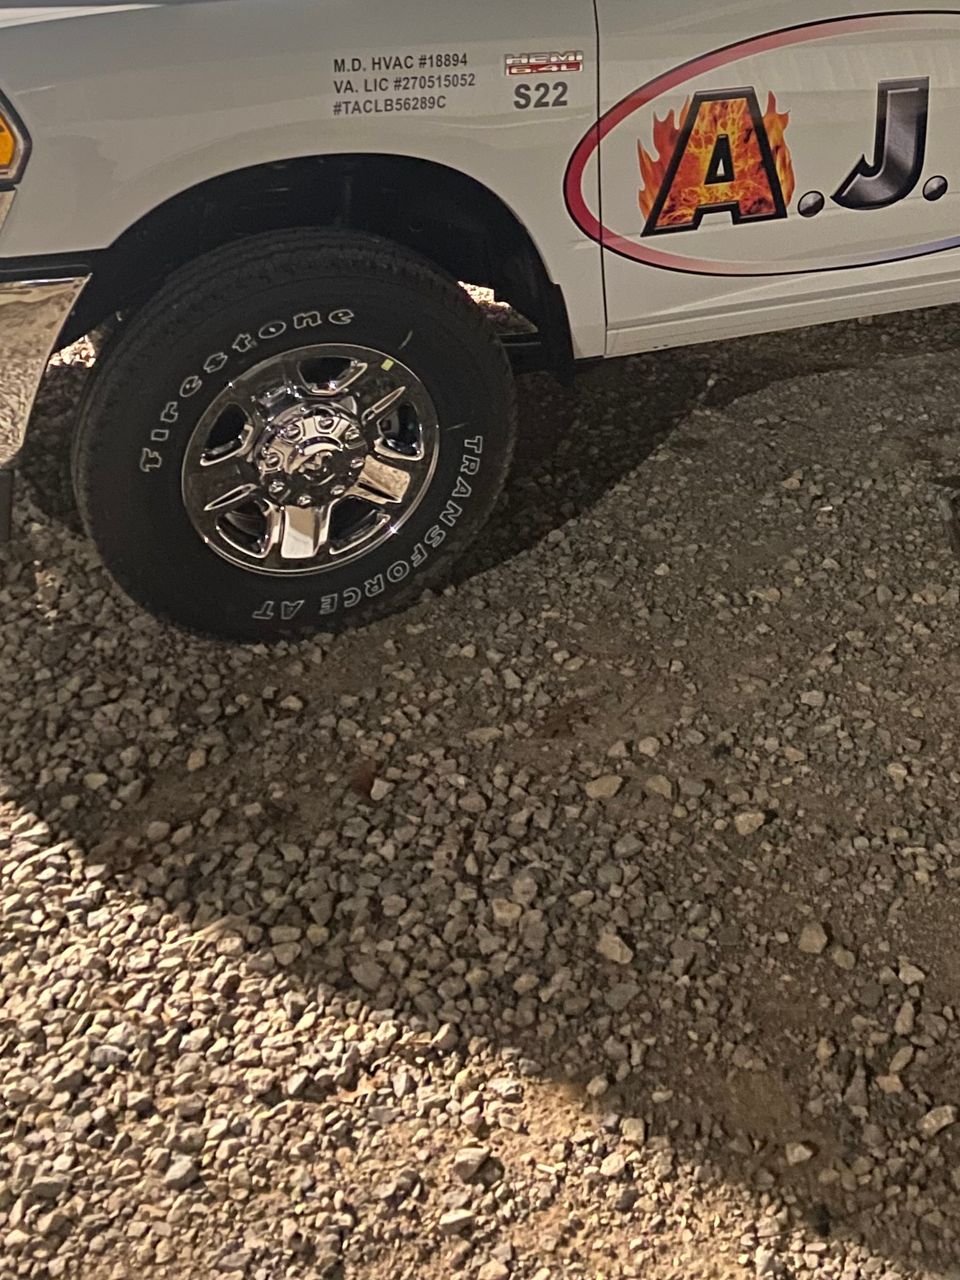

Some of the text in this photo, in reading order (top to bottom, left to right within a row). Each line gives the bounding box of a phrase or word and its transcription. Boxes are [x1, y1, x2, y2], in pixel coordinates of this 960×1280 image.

[334, 53, 468, 73] M.D. HVAC #18894
[506, 51, 583, 64] HEMI
[334, 73, 476, 94] VA. LIC #270515052
[333, 95, 447, 116] #TACLB56289C
[513, 81, 569, 110] S22
[140, 308, 355, 472] Firestone
[252, 435, 484, 620] TRANSFORCE AT
